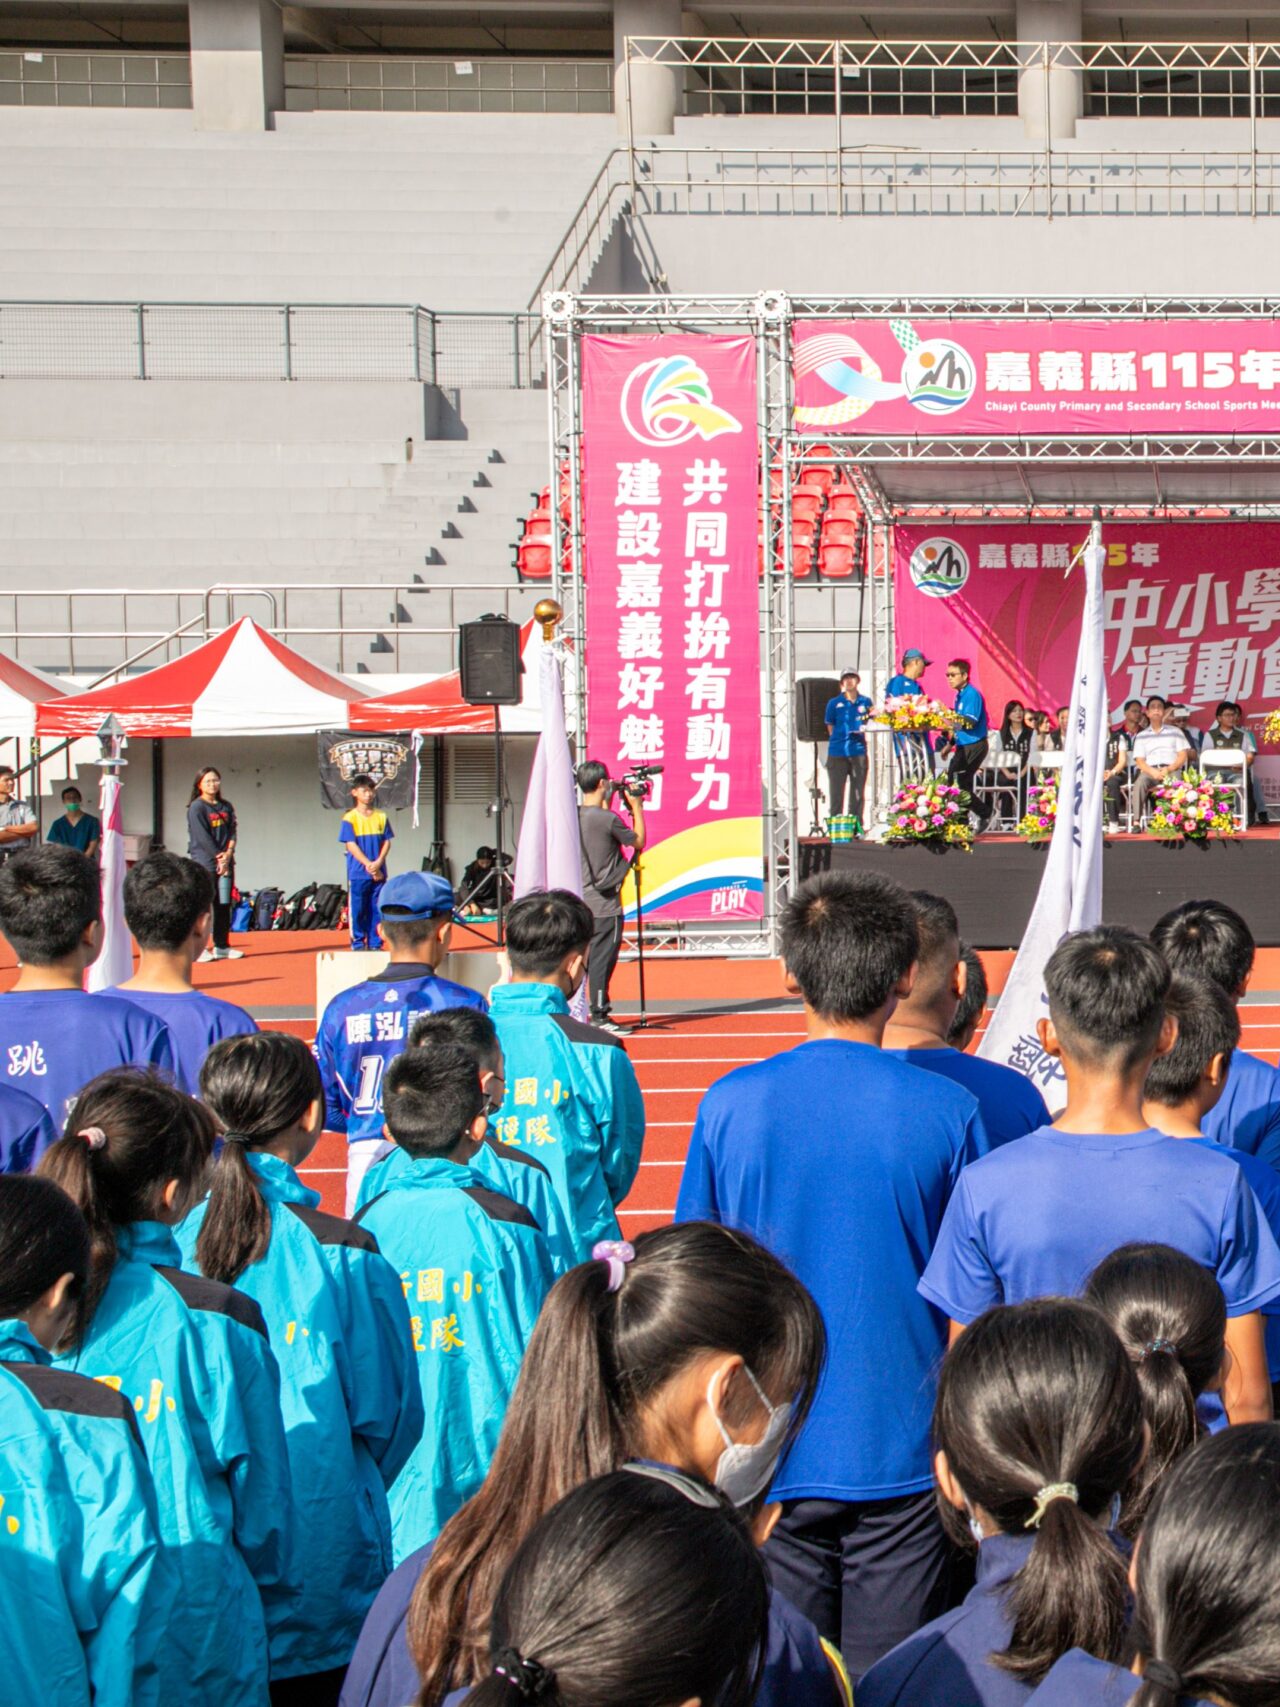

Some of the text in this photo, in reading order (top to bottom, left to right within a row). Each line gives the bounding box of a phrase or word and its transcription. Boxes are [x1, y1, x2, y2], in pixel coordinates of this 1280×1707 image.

[985, 401, 1018, 413] Chiayi
[1021, 401, 1056, 413] County
[1060, 401, 1101, 413] Primary
[1104, 402, 1123, 411] and
[1127, 401, 1182, 413] Secondary
[1185, 400, 1220, 411] School
[1223, 400, 1257, 412] Sports
[979, 542, 1160, 568] 嘉義縣15年
[711, 888, 748, 913] PLAY
[346, 1010, 432, 1044] 陳泓
[502, 1077, 569, 1106] 國小
